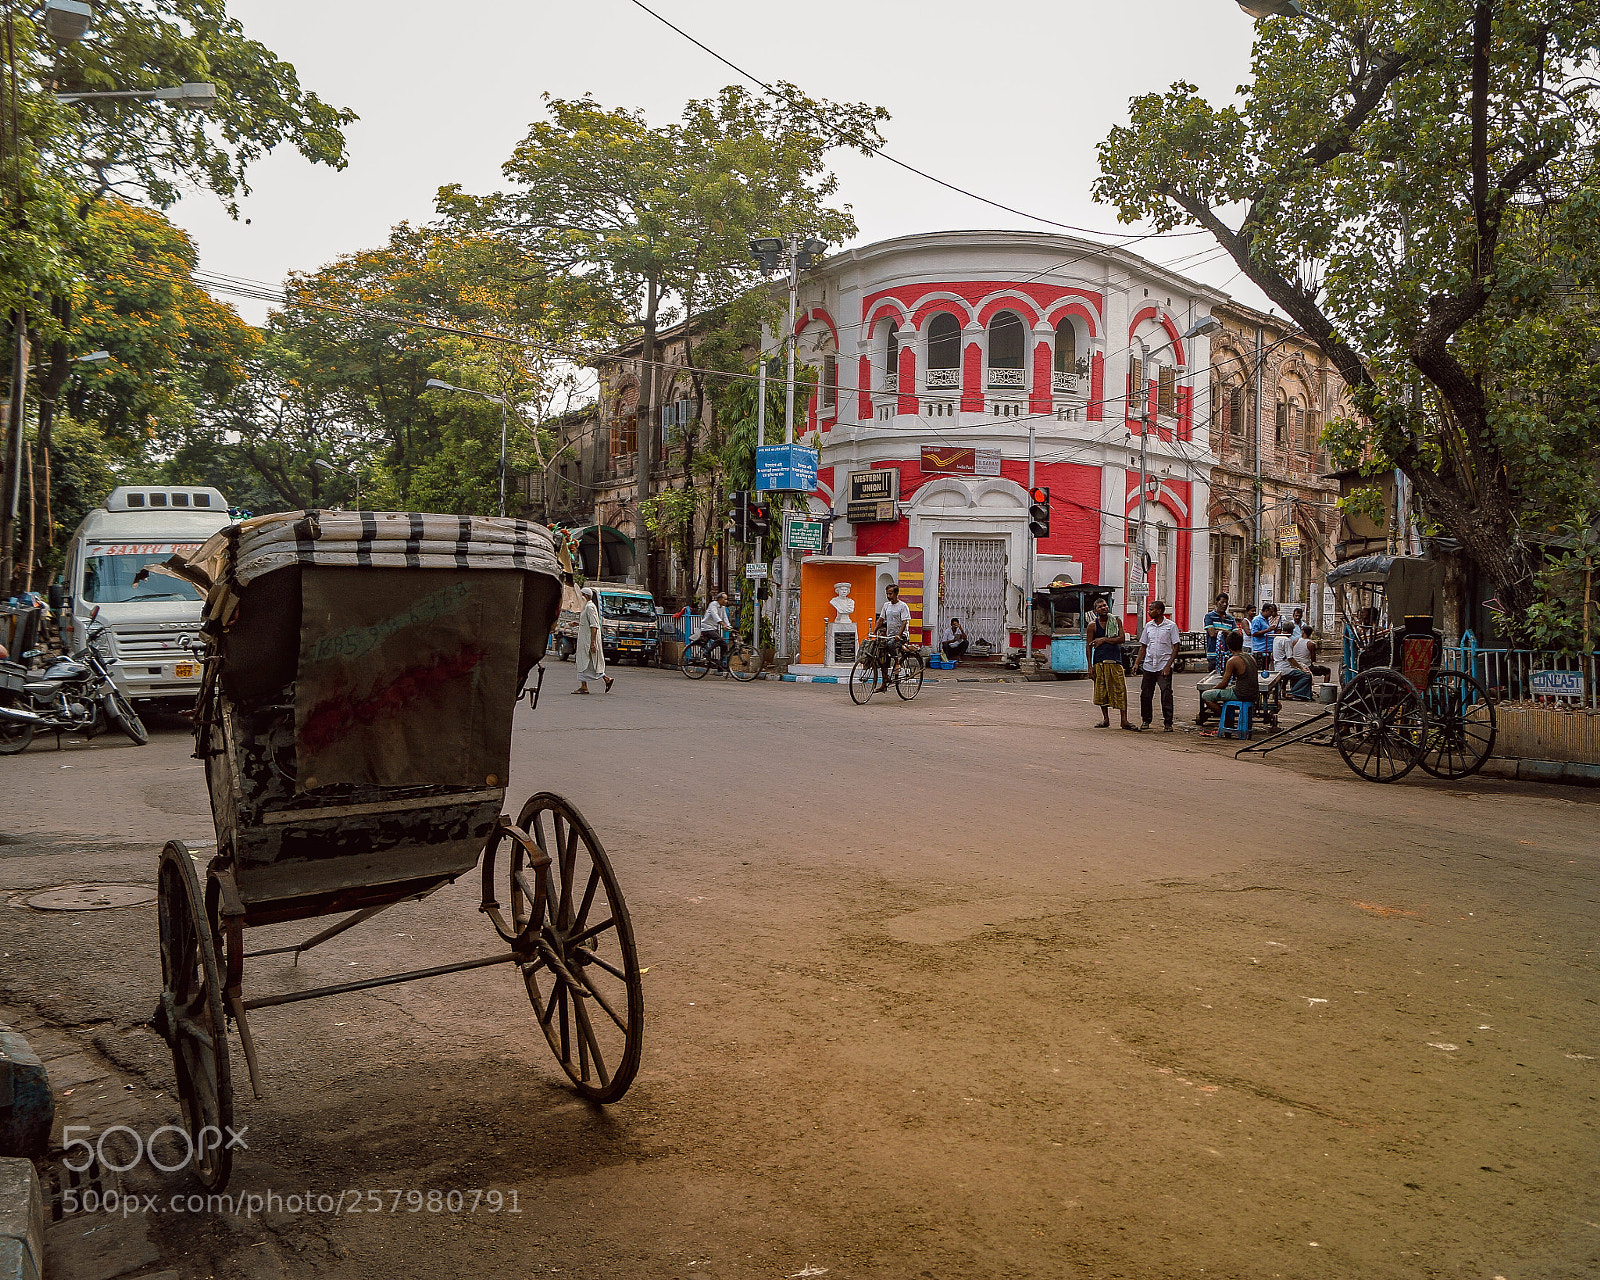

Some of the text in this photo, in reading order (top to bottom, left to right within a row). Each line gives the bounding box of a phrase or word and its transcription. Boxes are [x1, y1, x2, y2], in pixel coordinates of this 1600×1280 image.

[853, 474, 882, 483] WESTERN
[861, 484, 882, 492] UNION
[106, 544, 163, 555] SANTU
